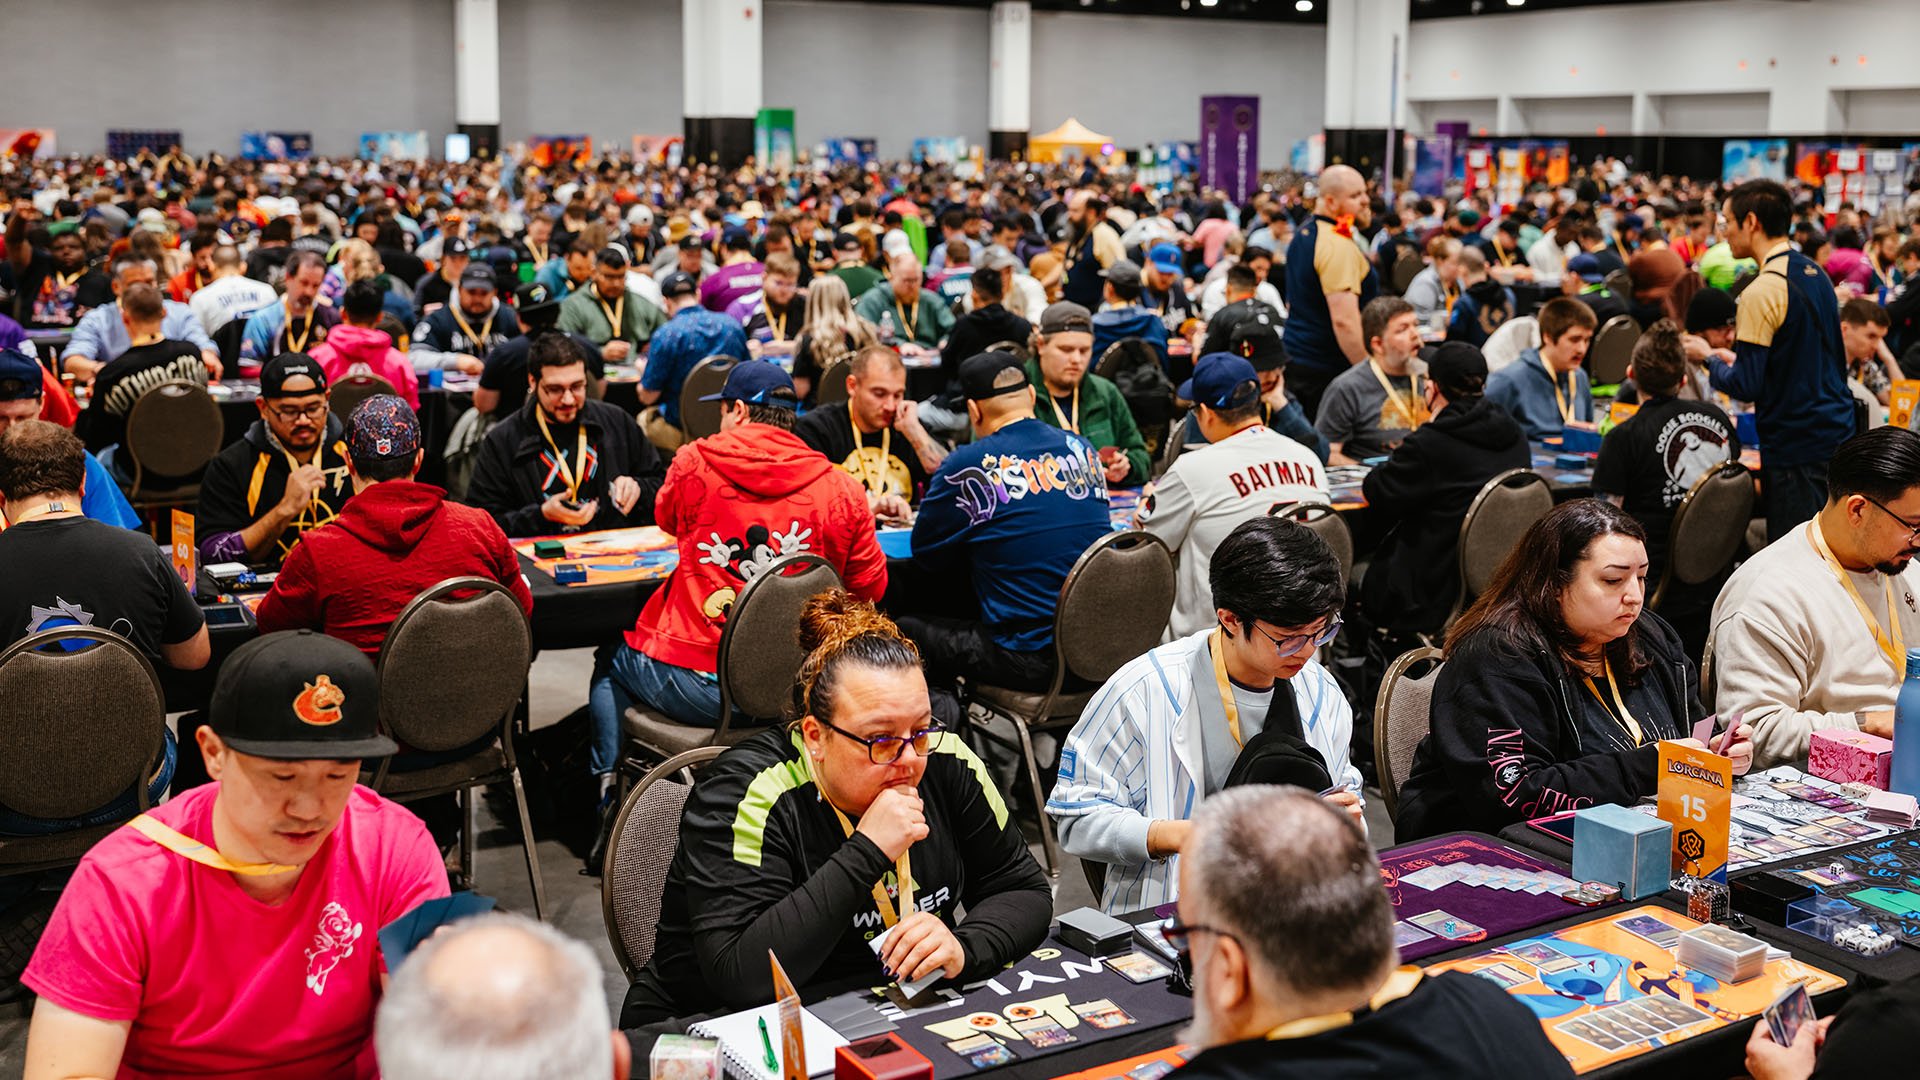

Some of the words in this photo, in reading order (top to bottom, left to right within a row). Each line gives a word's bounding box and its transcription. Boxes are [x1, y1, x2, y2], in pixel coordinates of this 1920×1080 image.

[1655, 417, 1679, 454] OOGIE
[944, 434, 1108, 526] Disneyl
[1229, 461, 1317, 498] BAYMAX
[177, 542, 189, 560] 60
[1667, 758, 1725, 788] LORCANA
[1680, 794, 1707, 822] 15
[853, 886, 950, 928] WYDER
